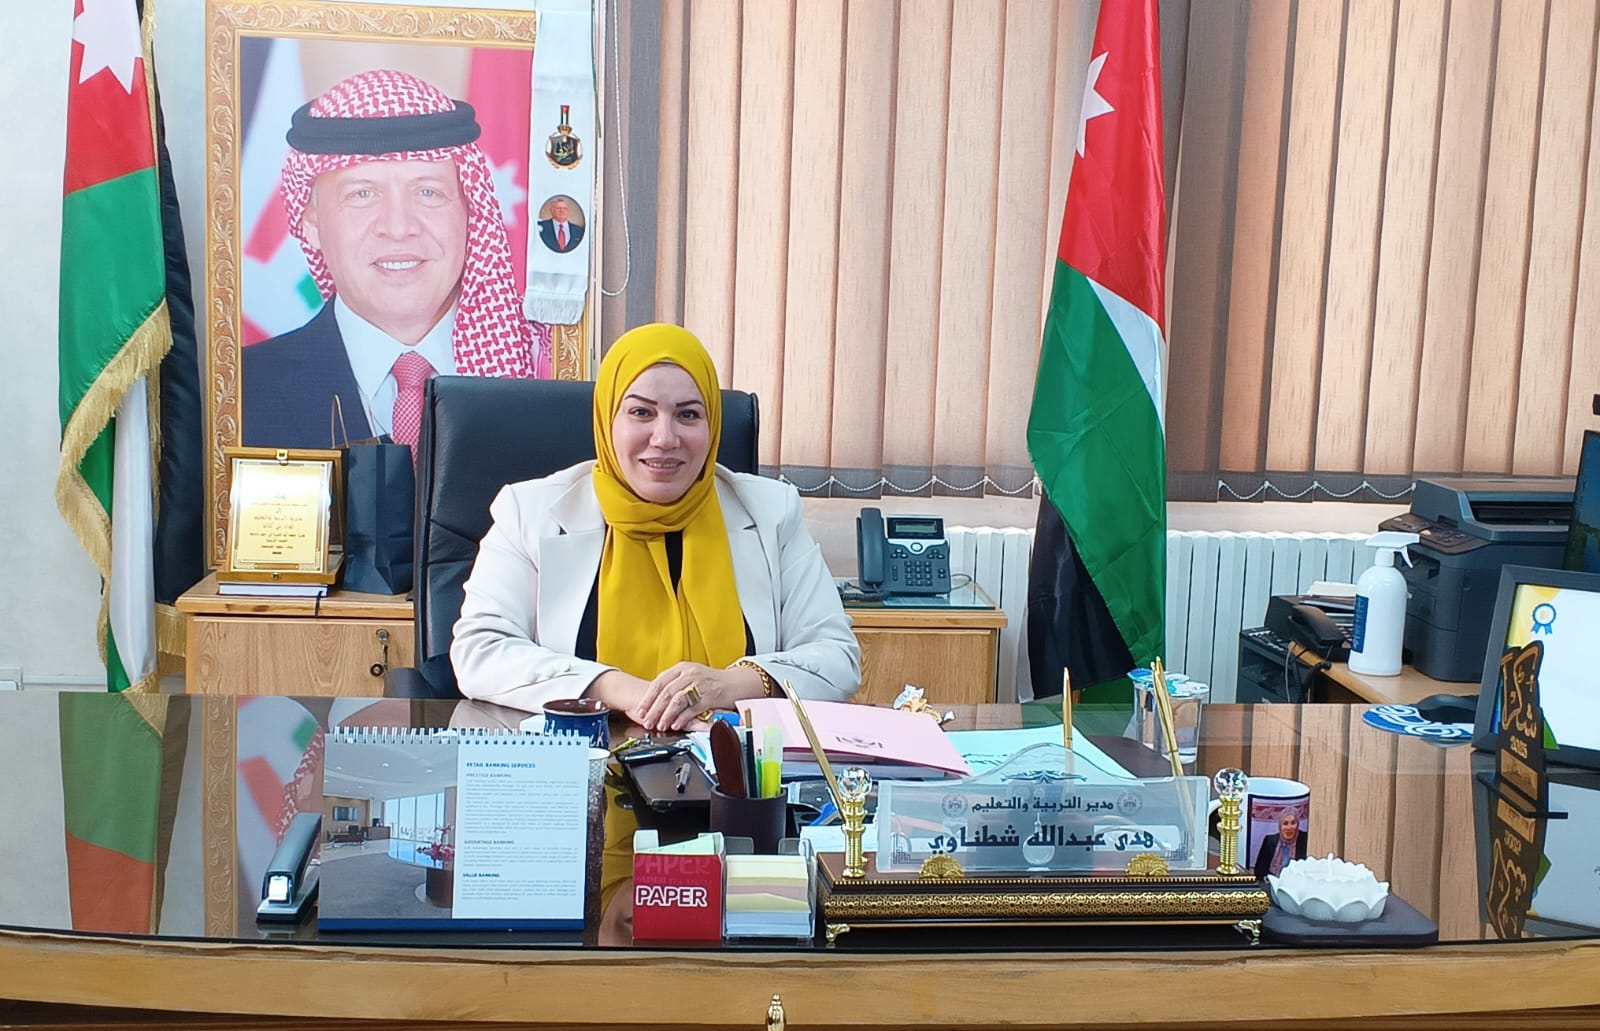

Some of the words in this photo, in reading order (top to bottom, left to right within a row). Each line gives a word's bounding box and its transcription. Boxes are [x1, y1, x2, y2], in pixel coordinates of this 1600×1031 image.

[1510, 735, 1528, 759] 2025
[971, 796, 1029, 813] والتعليم
[1033, 796, 1081, 812] التربية
[1084, 799, 1114, 813] مدير
[927, 824, 1020, 855] شطناوي
[1114, 830, 1154, 852] هدى
[635, 885, 708, 907] PAPER
